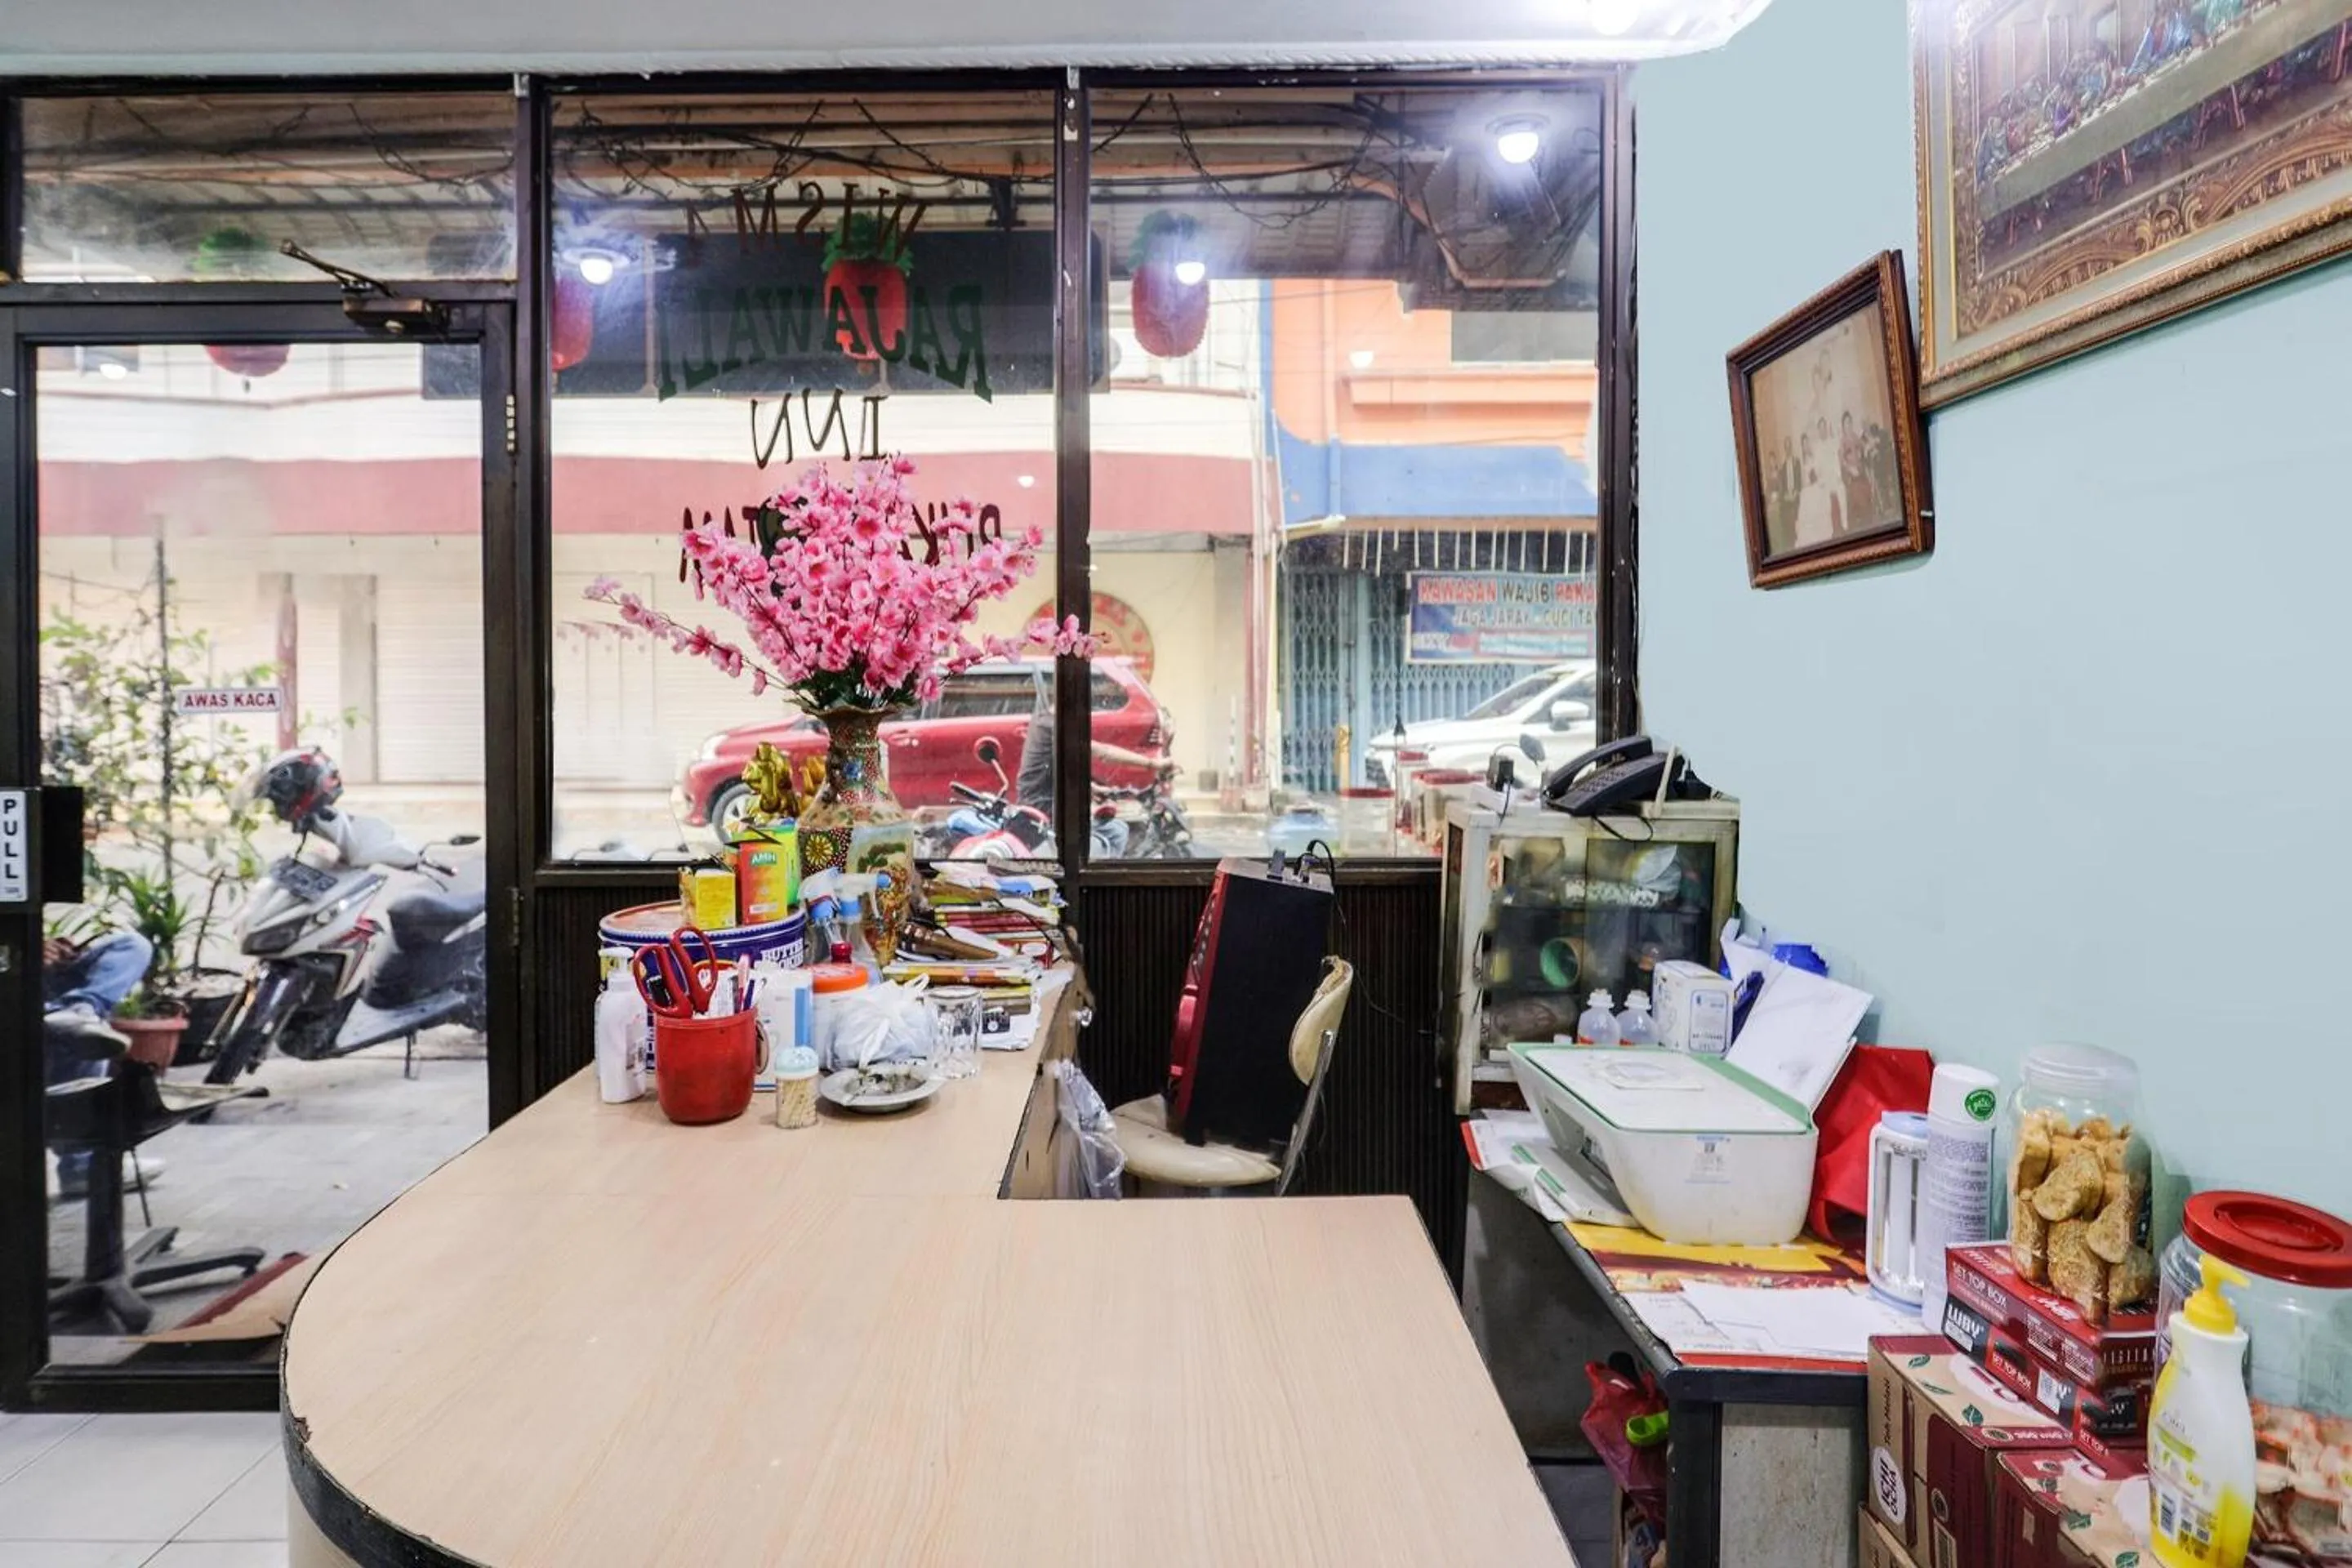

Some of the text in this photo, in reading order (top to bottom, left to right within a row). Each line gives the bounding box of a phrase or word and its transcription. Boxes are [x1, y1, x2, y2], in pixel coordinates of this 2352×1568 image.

[1418, 577, 1497, 604] KAWASAN
[1502, 581, 1550, 603] WAJIB
[1544, 608, 1575, 628] CUCI
[184, 693, 276, 707] AWAS KACA
[3, 799, 19, 879] PULL
[1953, 1261, 1969, 1281] SET
[1968, 1269, 1987, 1294] TOP
[1987, 1281, 2009, 1308] BOX
[1947, 1303, 1981, 1339] LUBY
[1879, 1456, 1891, 1507] ICHI
[1888, 1470, 1900, 1516] OCHA
